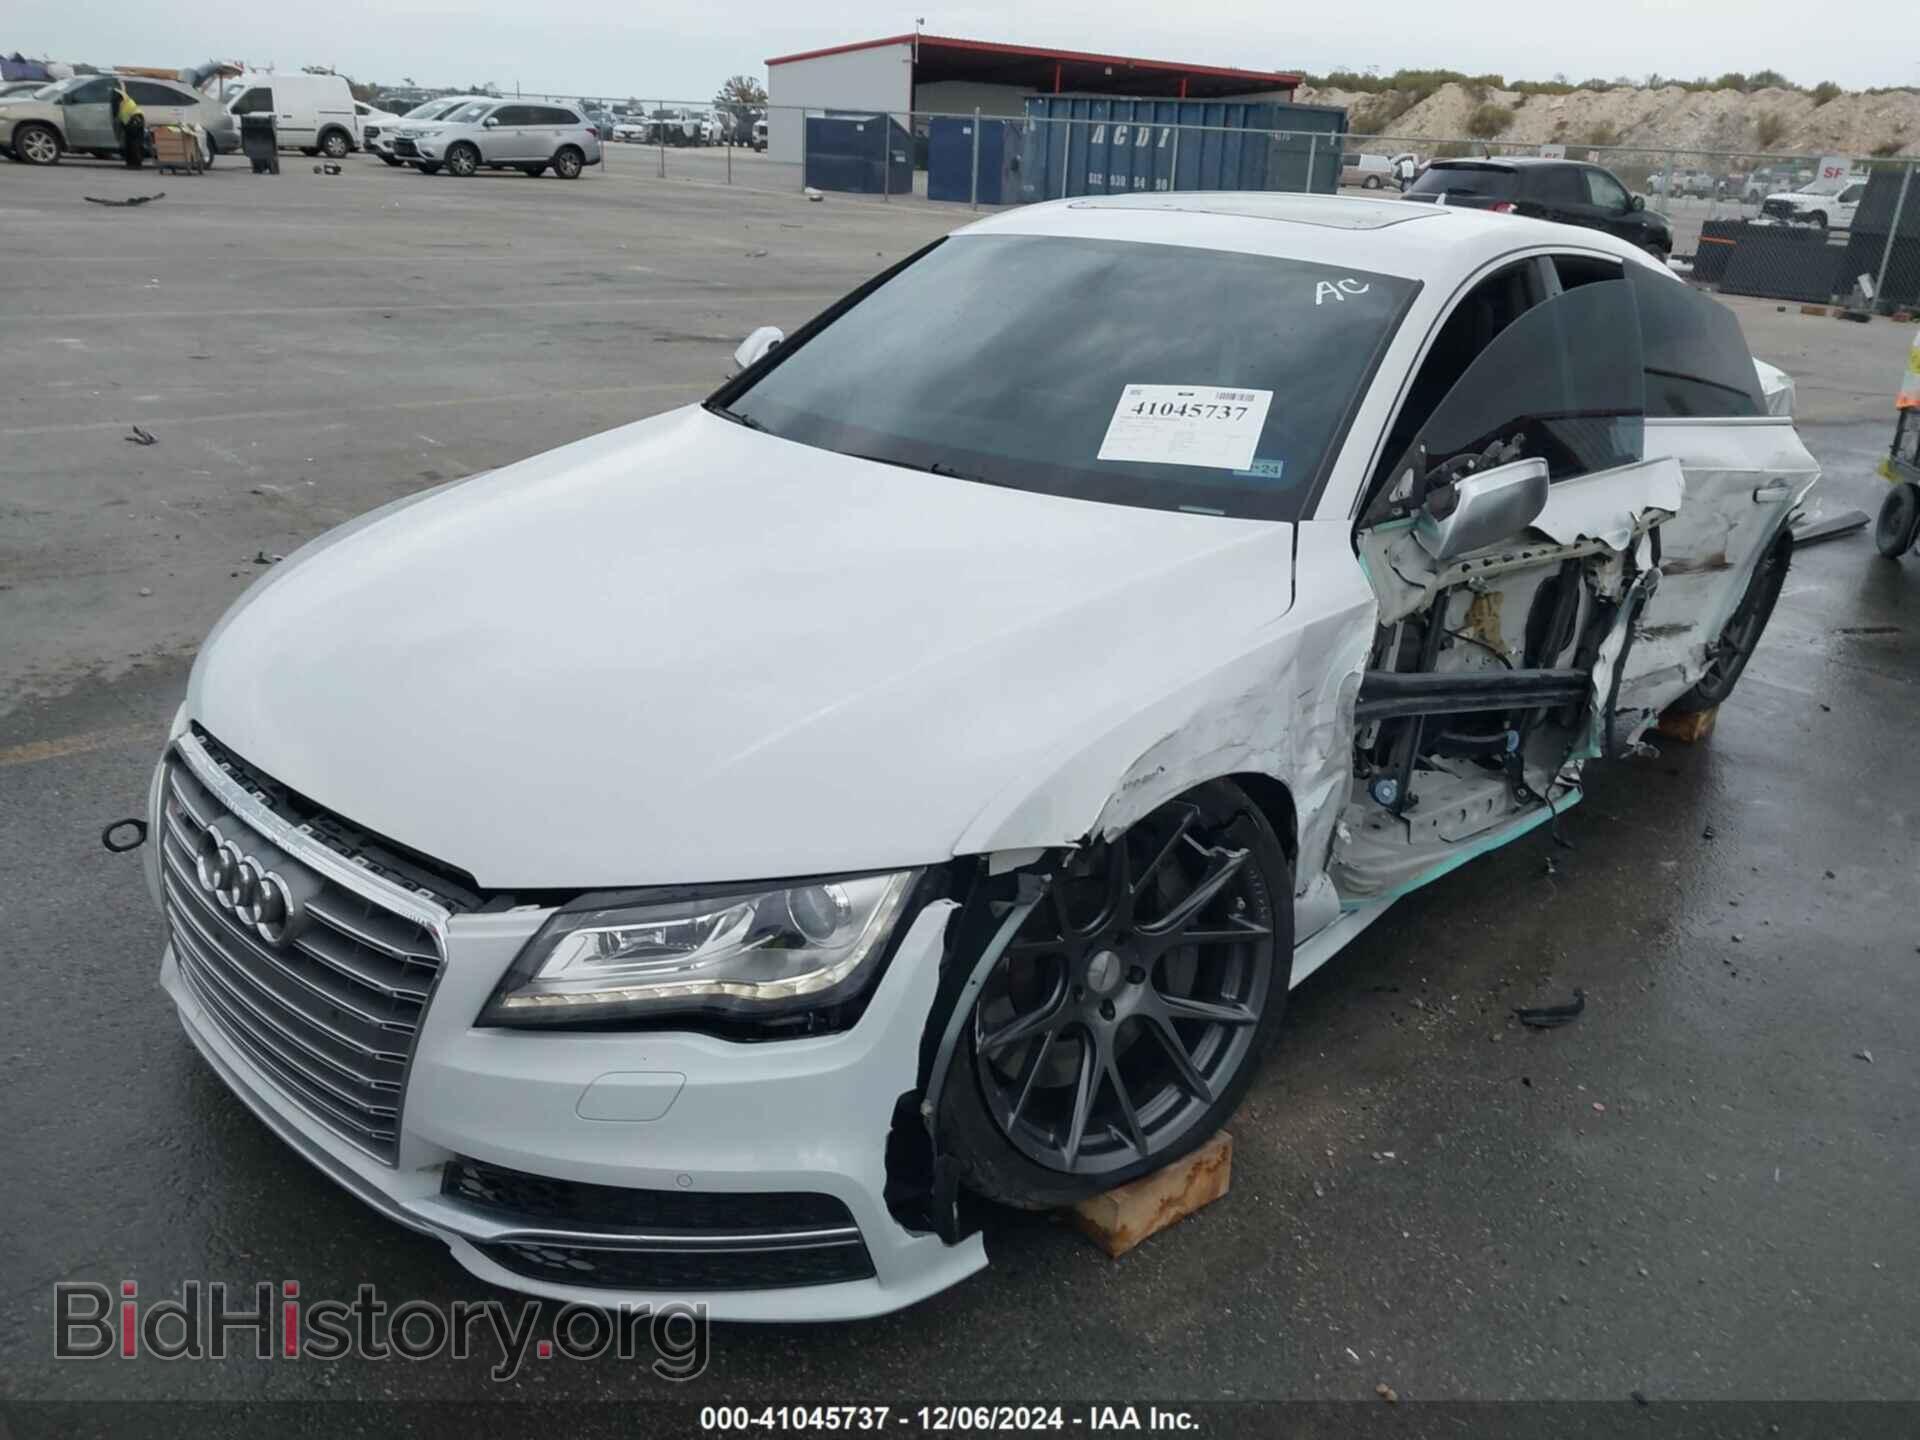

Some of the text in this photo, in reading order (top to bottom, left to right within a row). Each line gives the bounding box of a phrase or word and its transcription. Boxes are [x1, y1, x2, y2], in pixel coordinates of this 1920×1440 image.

[1824, 167, 1844, 178] SF
[1316, 278, 1369, 305] AC
[1131, 401, 1248, 421] 41045737
